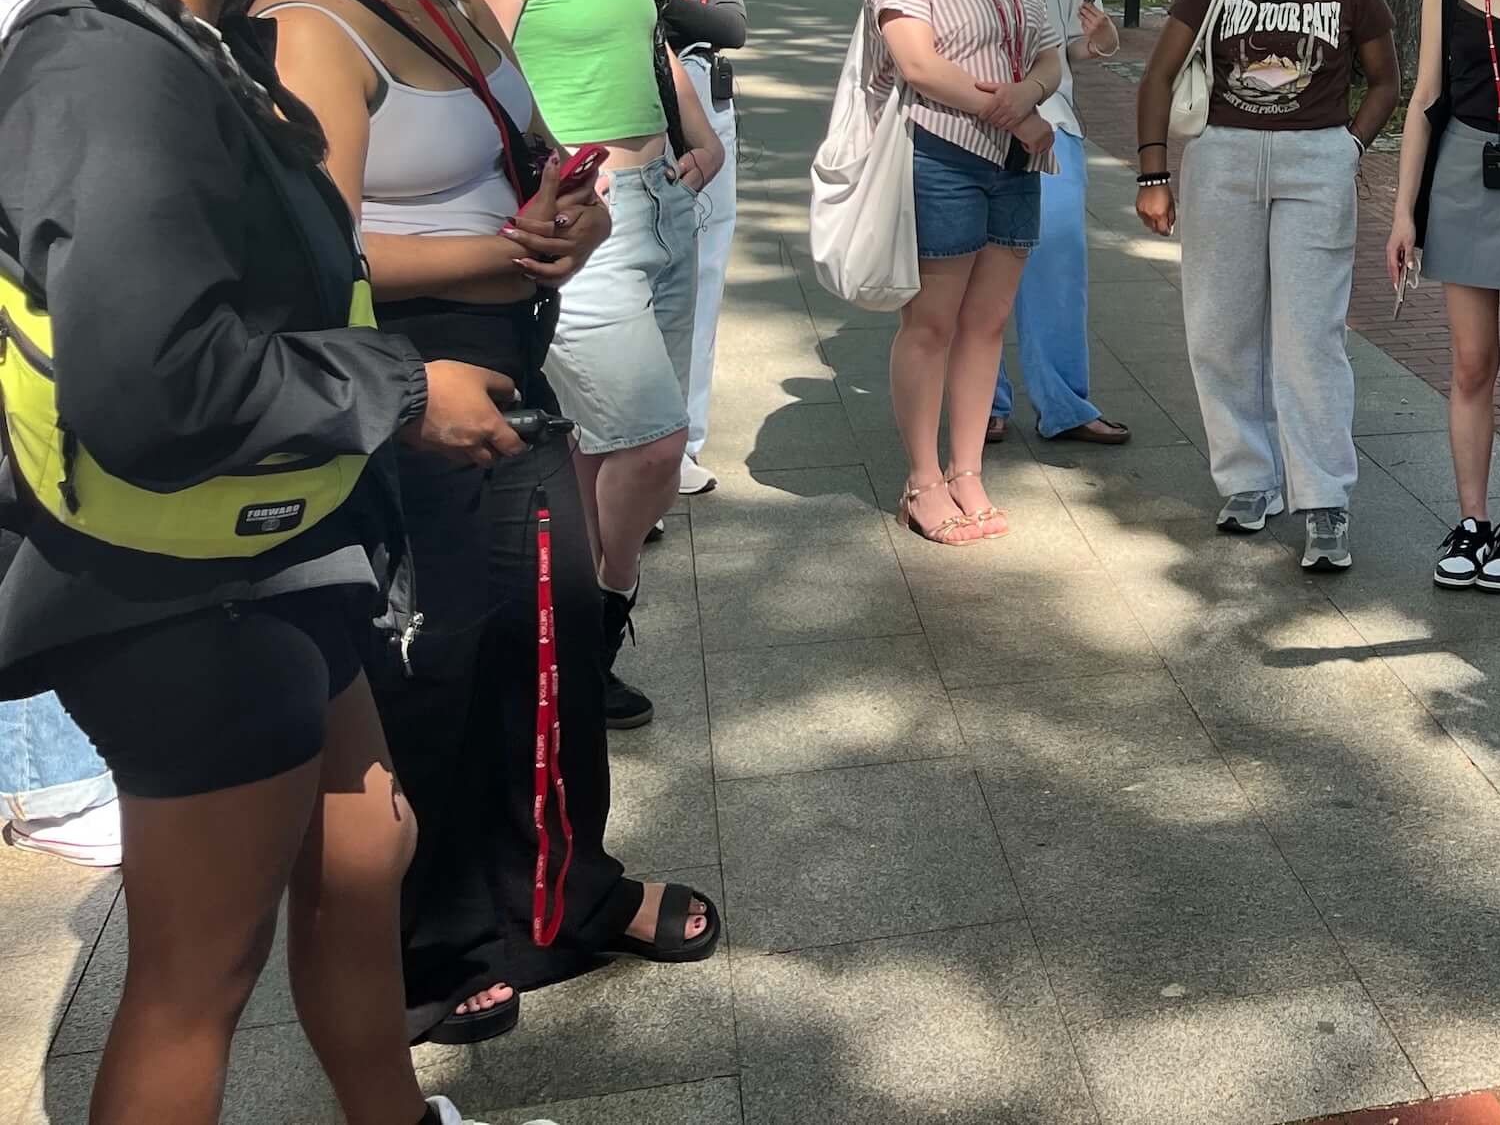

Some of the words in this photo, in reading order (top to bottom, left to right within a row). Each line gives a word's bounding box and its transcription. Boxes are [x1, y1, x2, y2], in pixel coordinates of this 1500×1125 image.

[1255, 2, 1301, 33] YOUR
[1302, 1, 1341, 50] PATH
[246, 504, 300, 518] FORWARD
